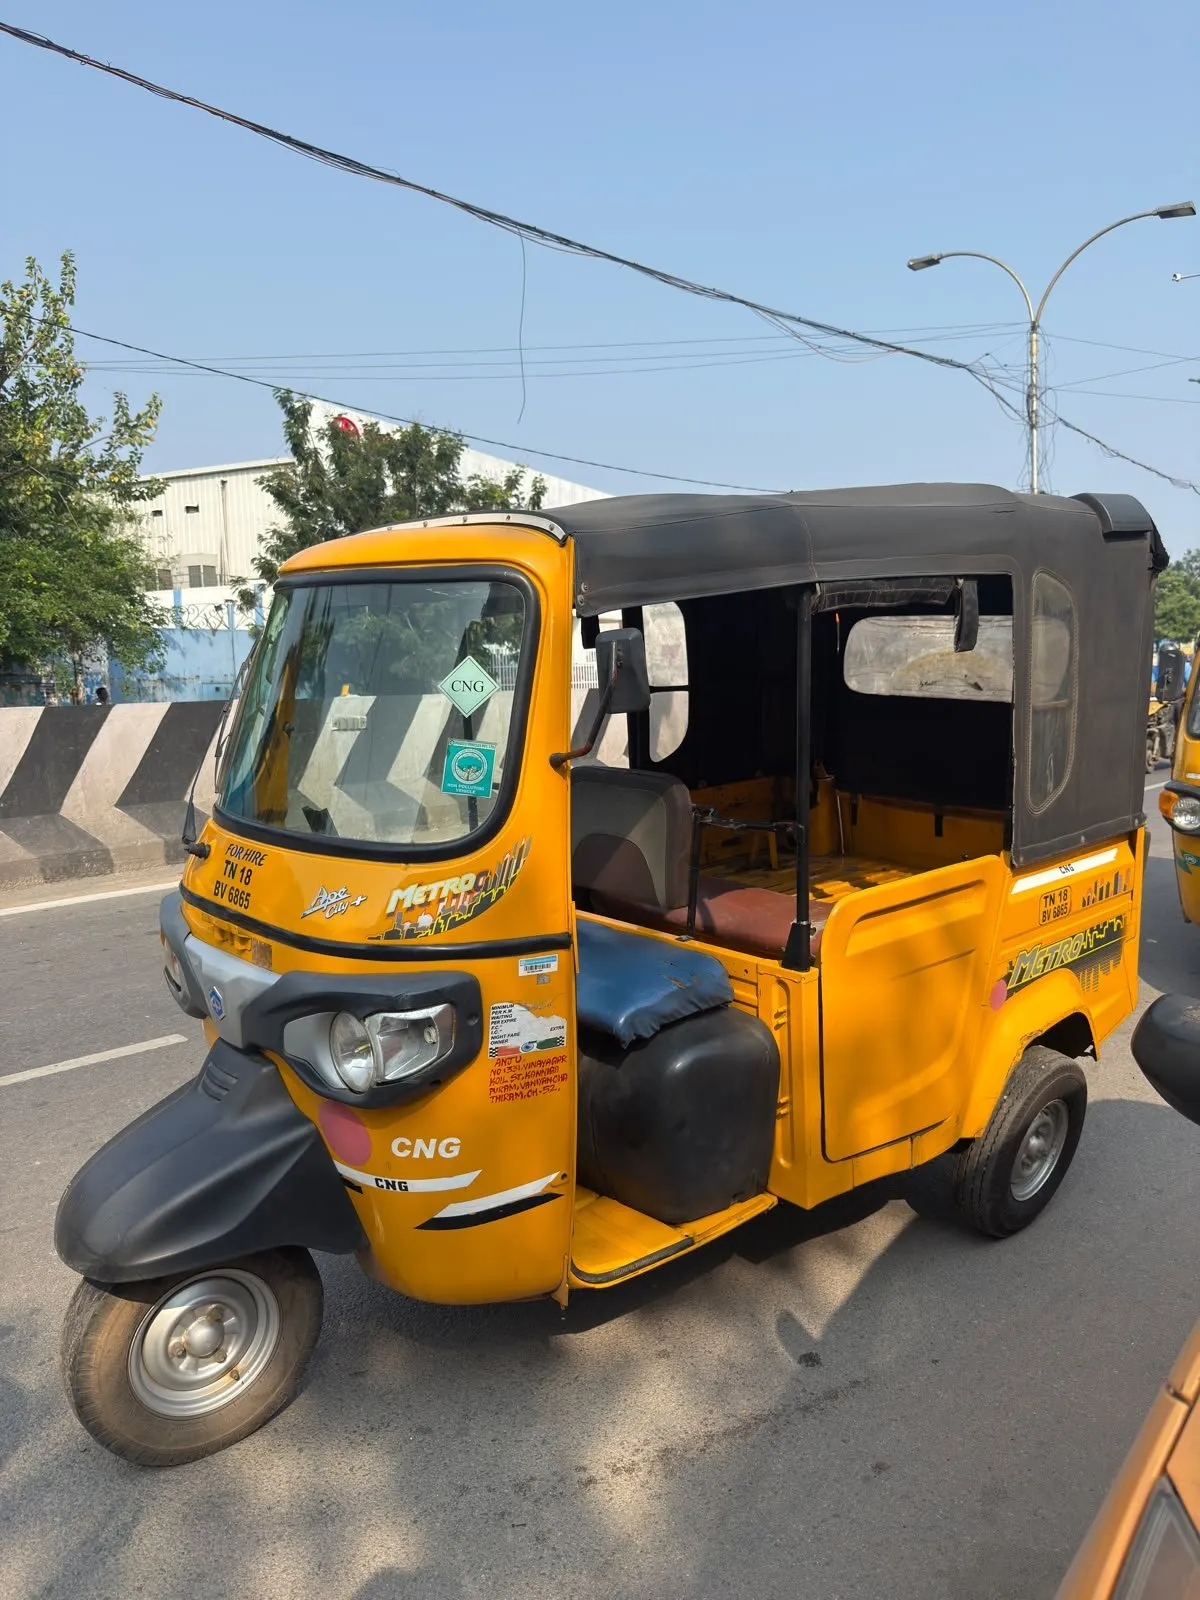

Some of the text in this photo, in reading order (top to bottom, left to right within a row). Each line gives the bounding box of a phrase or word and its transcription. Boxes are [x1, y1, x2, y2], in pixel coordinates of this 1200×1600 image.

[451, 680, 484, 692] CNG
[225, 843, 268, 866] FOR HIRE
[224, 860, 252, 886] TN 18
[1058, 863, 1075, 874] CNG
[214, 880, 251, 910] BV 6865
[303, 886, 350, 912] Ape
[386, 872, 477, 916] METRO
[1044, 889, 1068, 908] TN 18
[324, 902, 349, 919] City
[1042, 902, 1068, 922] BV 6865
[1008, 932, 1084, 990] METRO
[390, 1136, 461, 1158] CNG
[374, 1177, 409, 1192] CNG
